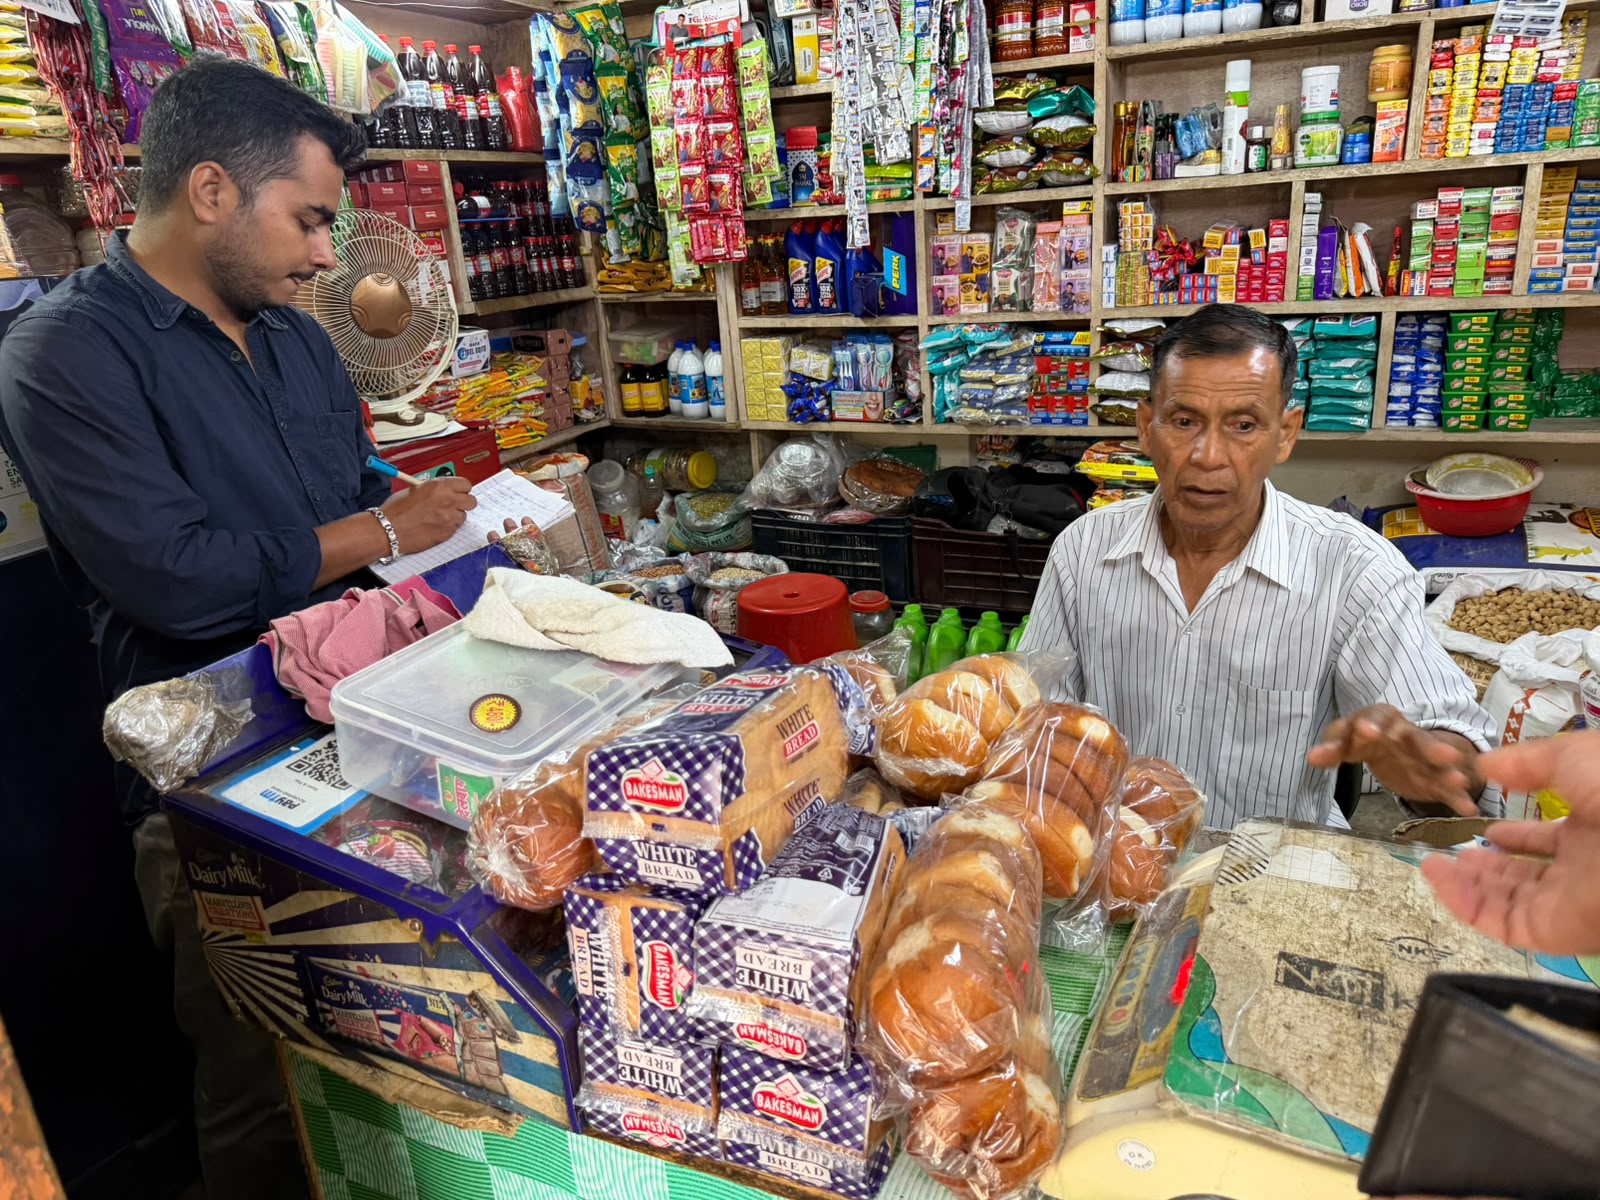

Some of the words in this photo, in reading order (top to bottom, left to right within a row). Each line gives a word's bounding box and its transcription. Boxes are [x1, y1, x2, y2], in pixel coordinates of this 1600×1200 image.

[891, 255, 901, 289] PERK
[776, 704, 814, 740] WHITE
[785, 723, 817, 754] BREAD
[625, 780, 685, 803] BAKESMAN
[783, 778, 820, 817] WHITE
[794, 797, 825, 828] BREAD
[632, 839, 698, 868] WHITE
[188, 861, 227, 888] Dairy
[227, 862, 265, 888] Milk
[643, 863, 696, 881] BREAD
[574, 934, 590, 989] BREAD
[587, 932, 609, 1000] WHITE
[651, 943, 675, 1007] BAKESMAN
[744, 950, 803, 975] BREAD
[321, 985, 347, 1004] Dairy
[346, 987, 373, 1009] Milk
[735, 966, 812, 1003] WHITE
[736, 1023, 803, 1055] BAKESMAN
[622, 1051, 675, 1073] BREAD
[618, 1063, 685, 1097] WHITE
[756, 1093, 820, 1124] BAKESMAN
[623, 1116, 685, 1141] BAKESMAN
[767, 1155, 824, 1176] BREAD
